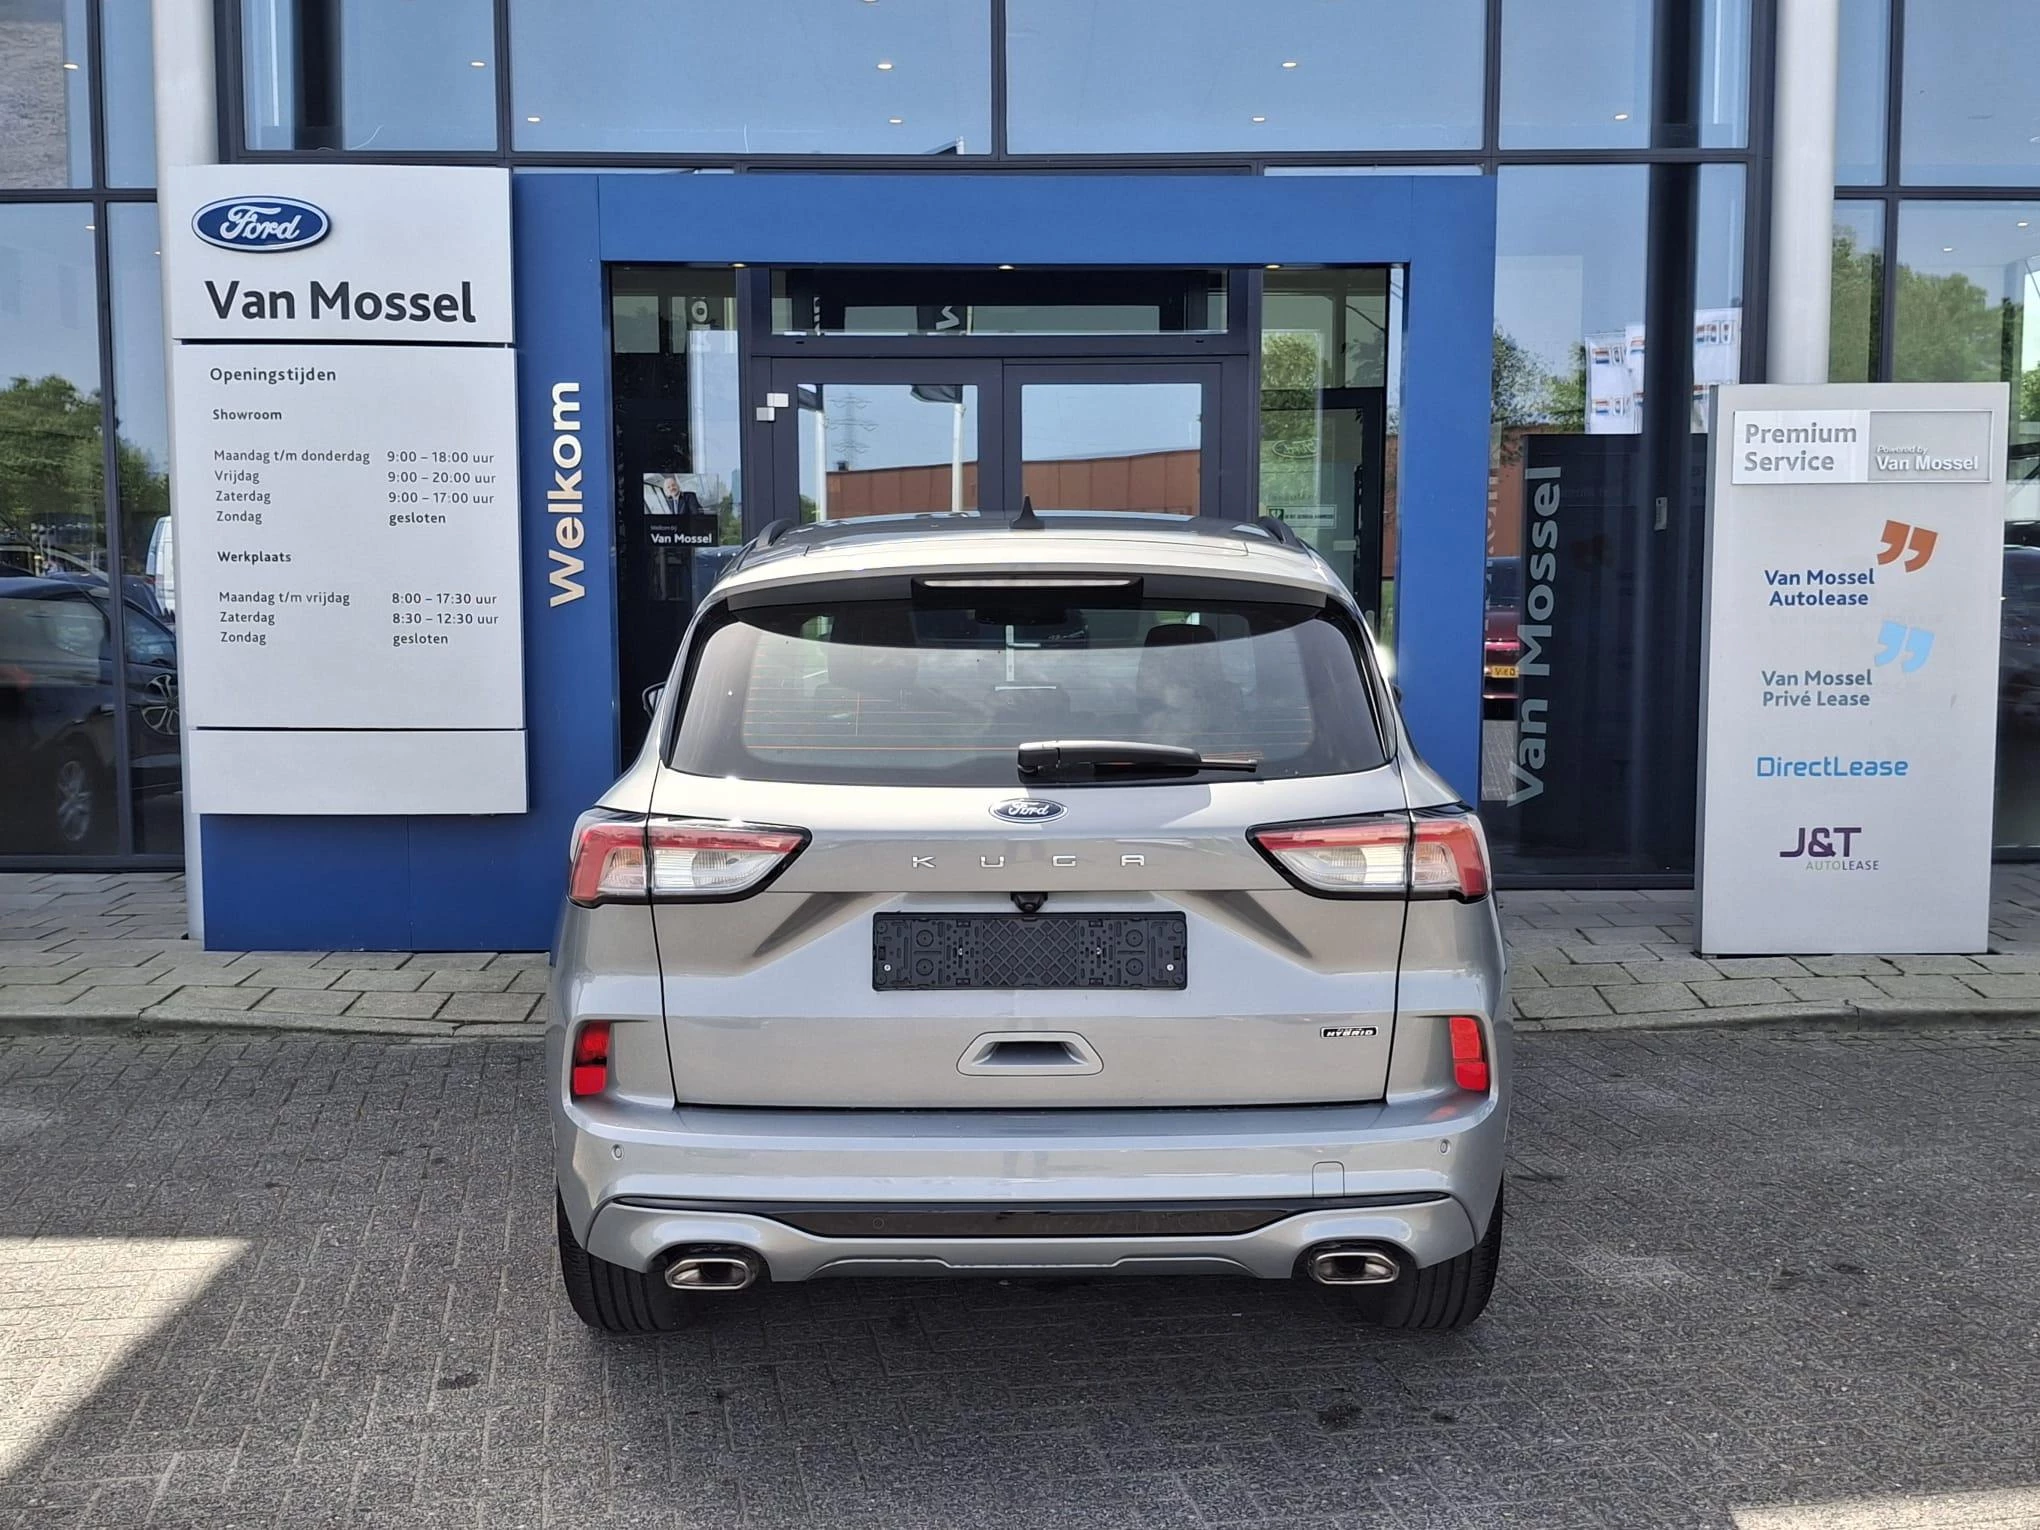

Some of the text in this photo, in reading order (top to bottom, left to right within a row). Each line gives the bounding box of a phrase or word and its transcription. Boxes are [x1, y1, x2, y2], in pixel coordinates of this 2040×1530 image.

[218, 203, 304, 241] Ford
[204, 280, 477, 324] Van Mossel
[209, 366, 336, 385] Openingstijden
[212, 408, 283, 421] Showroom
[1744, 421, 1858, 444] Premium
[214, 448, 271, 465] Maandag
[273, 449, 298, 462] t/m
[300, 449, 371, 466] donderdag
[386, 450, 417, 463] 9:00
[431, 451, 469, 463] 18:00
[472, 454, 495, 464] uur
[1876, 445, 1929, 455] Powered by
[1743, 449, 1835, 472] Service
[1876, 455, 1979, 471] Van Mossel
[214, 469, 260, 485] Vrijdag
[387, 471, 418, 483] 9:00
[432, 471, 471, 484] 20:00
[474, 475, 497, 484] uur
[215, 489, 272, 505] Zaterdag
[388, 491, 418, 504] 9:00
[432, 492, 469, 504] 17:00
[472, 495, 495, 504] uur
[547, 382, 585, 607] Welkom
[216, 510, 446, 527] Zondag gesloten
[650, 532, 713, 544] Van Mossel
[216, 550, 292, 566] Werkplaats
[1764, 567, 1875, 586] Van Mossel
[219, 591, 276, 606] Maandag
[278, 591, 303, 603] t/m
[305, 591, 351, 607] vrijdag
[391, 592, 422, 604] 8:00
[436, 592, 472, 605] 17:30
[475, 596, 497, 605] uur
[1768, 588, 1869, 607] Autolease
[219, 610, 276, 626] Zaterdag
[392, 612, 422, 624] 8:30
[436, 612, 473, 625] 12:30
[477, 615, 499, 625] uur
[220, 631, 449, 648] Zondag gesloten
[1506, 466, 1562, 808] Van Mossel
[1761, 668, 1873, 687] Van Mossel
[1762, 689, 1871, 707] Privé Lease
[1756, 755, 1909, 777] DirectLease
[1008, 801, 1050, 817] Ford
[1779, 826, 1863, 858] J&T
[911, 854, 1145, 868] KUGA
[1806, 859, 1880, 871] AUTOLEASE
